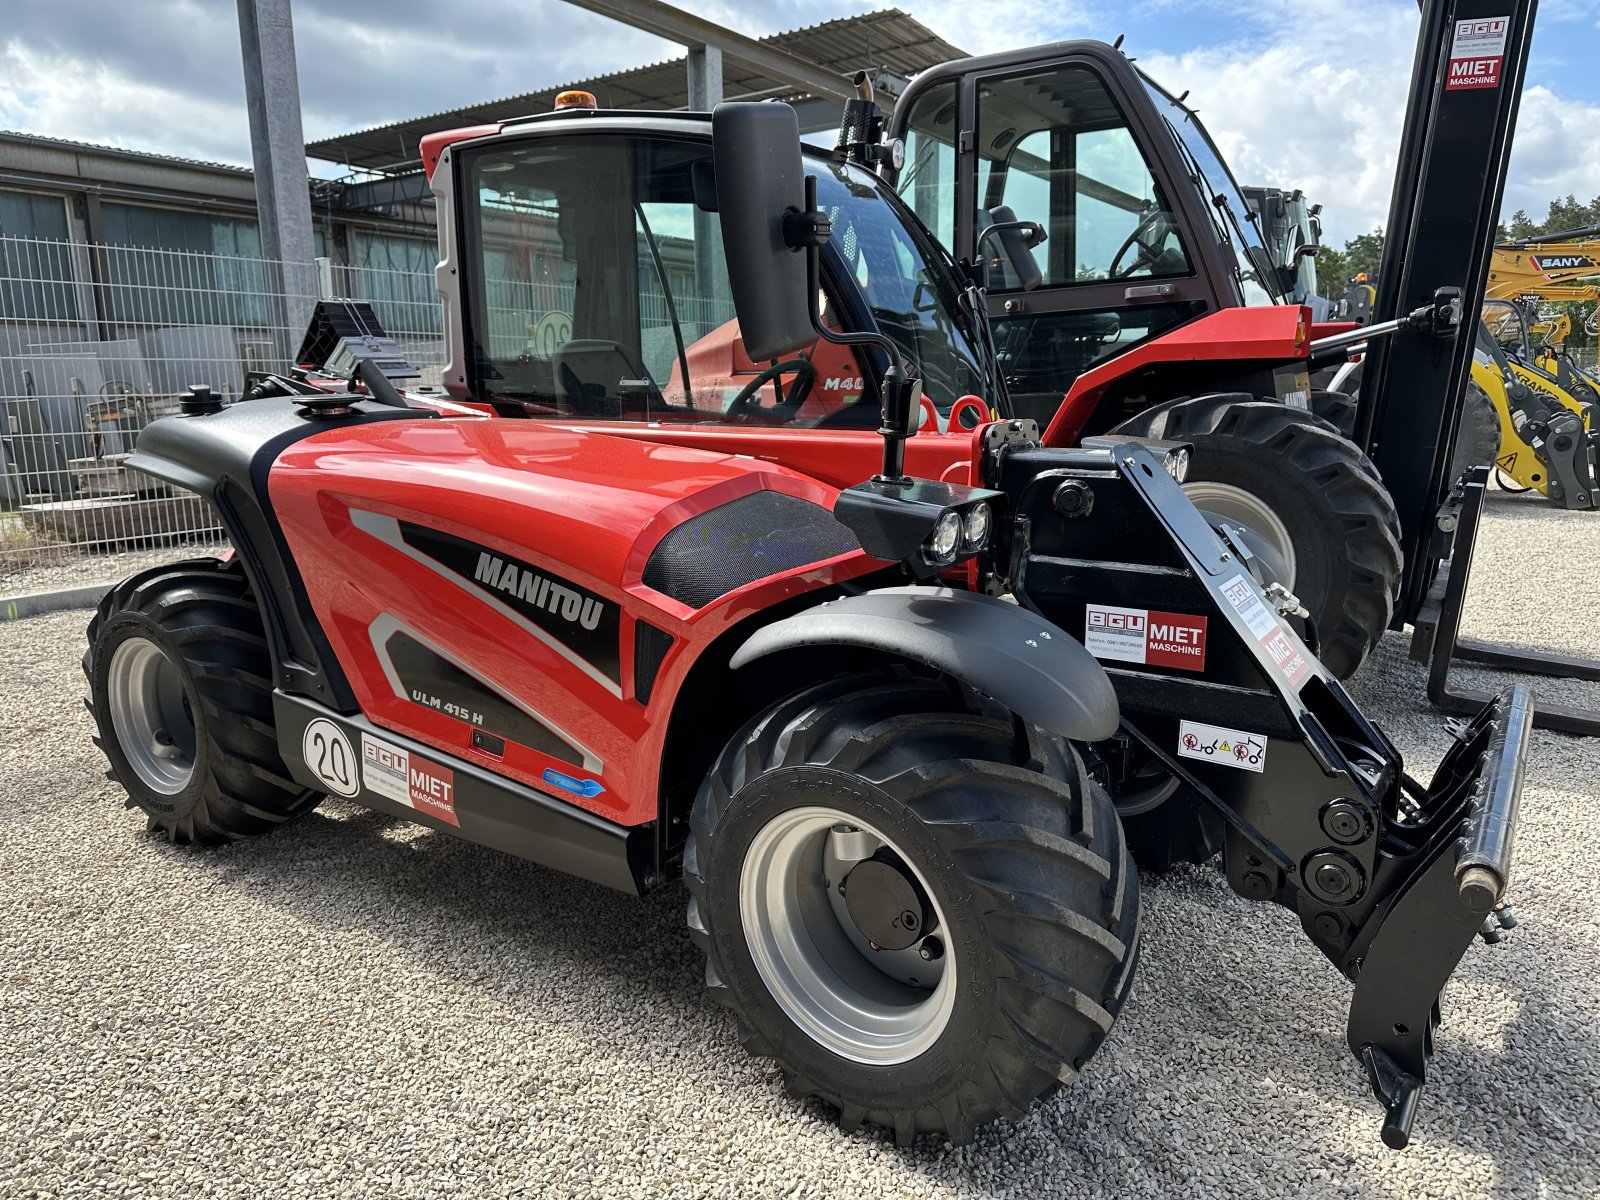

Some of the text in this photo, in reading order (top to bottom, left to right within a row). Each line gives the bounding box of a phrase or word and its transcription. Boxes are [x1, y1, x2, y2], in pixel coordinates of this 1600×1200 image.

[1458, 21, 1505, 36] BGU
[1451, 60, 1498, 76] MIET
[1450, 76, 1496, 85] MASCHINE
[1541, 257, 1583, 268] SANY
[474, 551, 604, 631] MANITOU
[1089, 611, 1145, 631] BGU
[1150, 623, 1203, 645] MIET
[1150, 641, 1202, 656] MASCHINE
[1265, 631, 1294, 665] MIET
[412, 689, 484, 726] ULM 415 H
[314, 732, 350, 786] 20
[364, 741, 408, 776] BGU
[411, 768, 452, 801] MIET
[411, 789, 453, 814] MASCHINE
